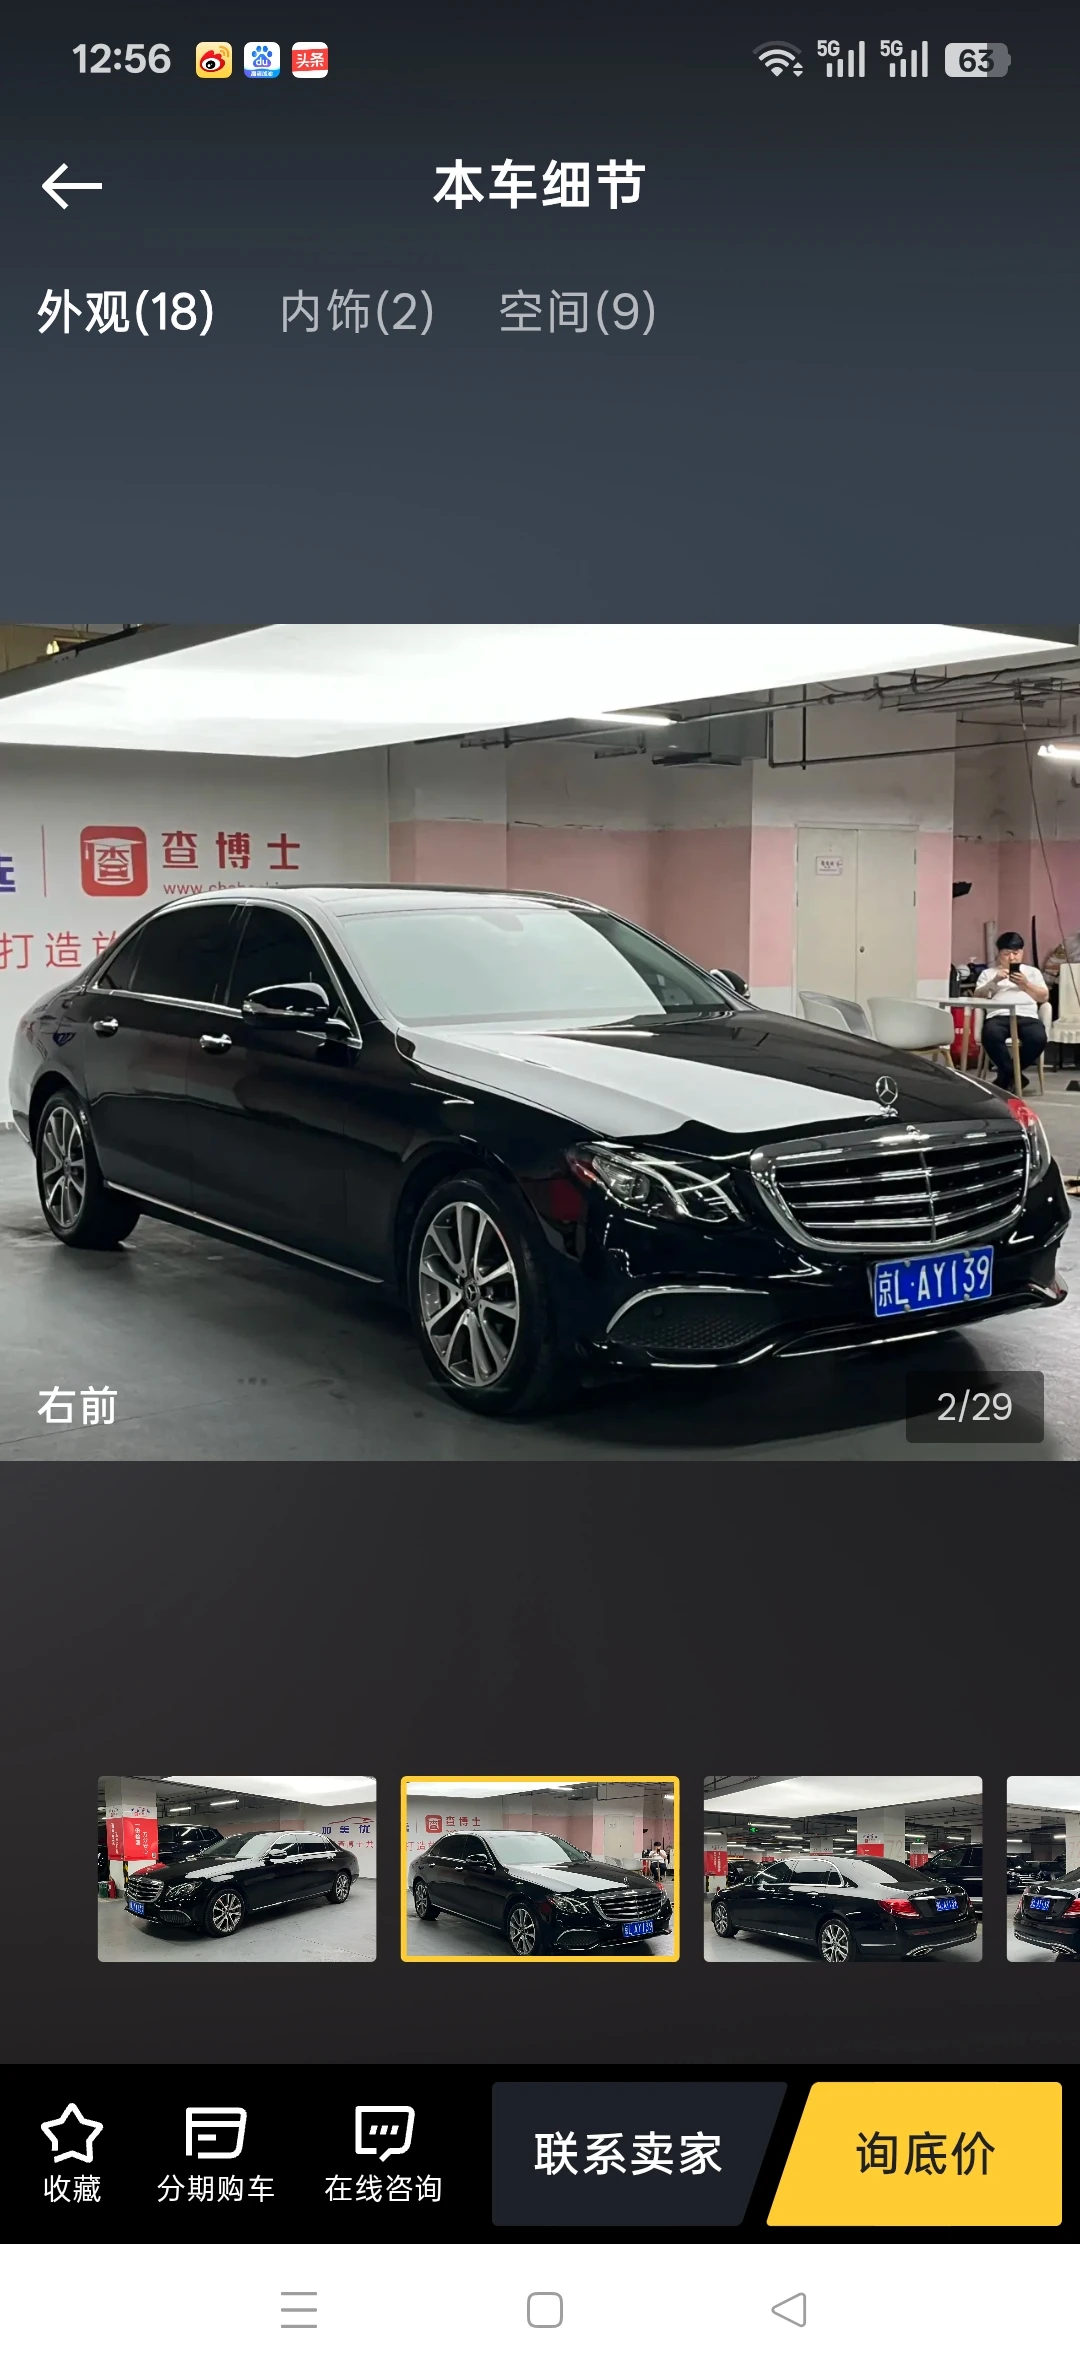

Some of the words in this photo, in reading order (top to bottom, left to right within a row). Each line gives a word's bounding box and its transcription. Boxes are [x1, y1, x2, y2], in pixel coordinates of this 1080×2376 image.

[73, 43, 171, 74] 12:56
[296, 53, 325, 68] 头条
[817, 39, 841, 57] 5G
[880, 39, 904, 57] 5G
[958, 49, 995, 73] 63
[432, 158, 646, 210] 本车细节
[36, 288, 213, 337] 外观(18)
[282, 288, 433, 336] 内饰(2)
[499, 288, 655, 336] 空间(9)
[161, 831, 301, 871] 查博士
[534, 2130, 723, 2176] 联系卖家
[856, 2130, 996, 2176] 询底价
[43, 2173, 102, 2204] 收藏
[157, 2173, 275, 2203] 分期购车
[324, 2173, 442, 2203] 在线咨询
